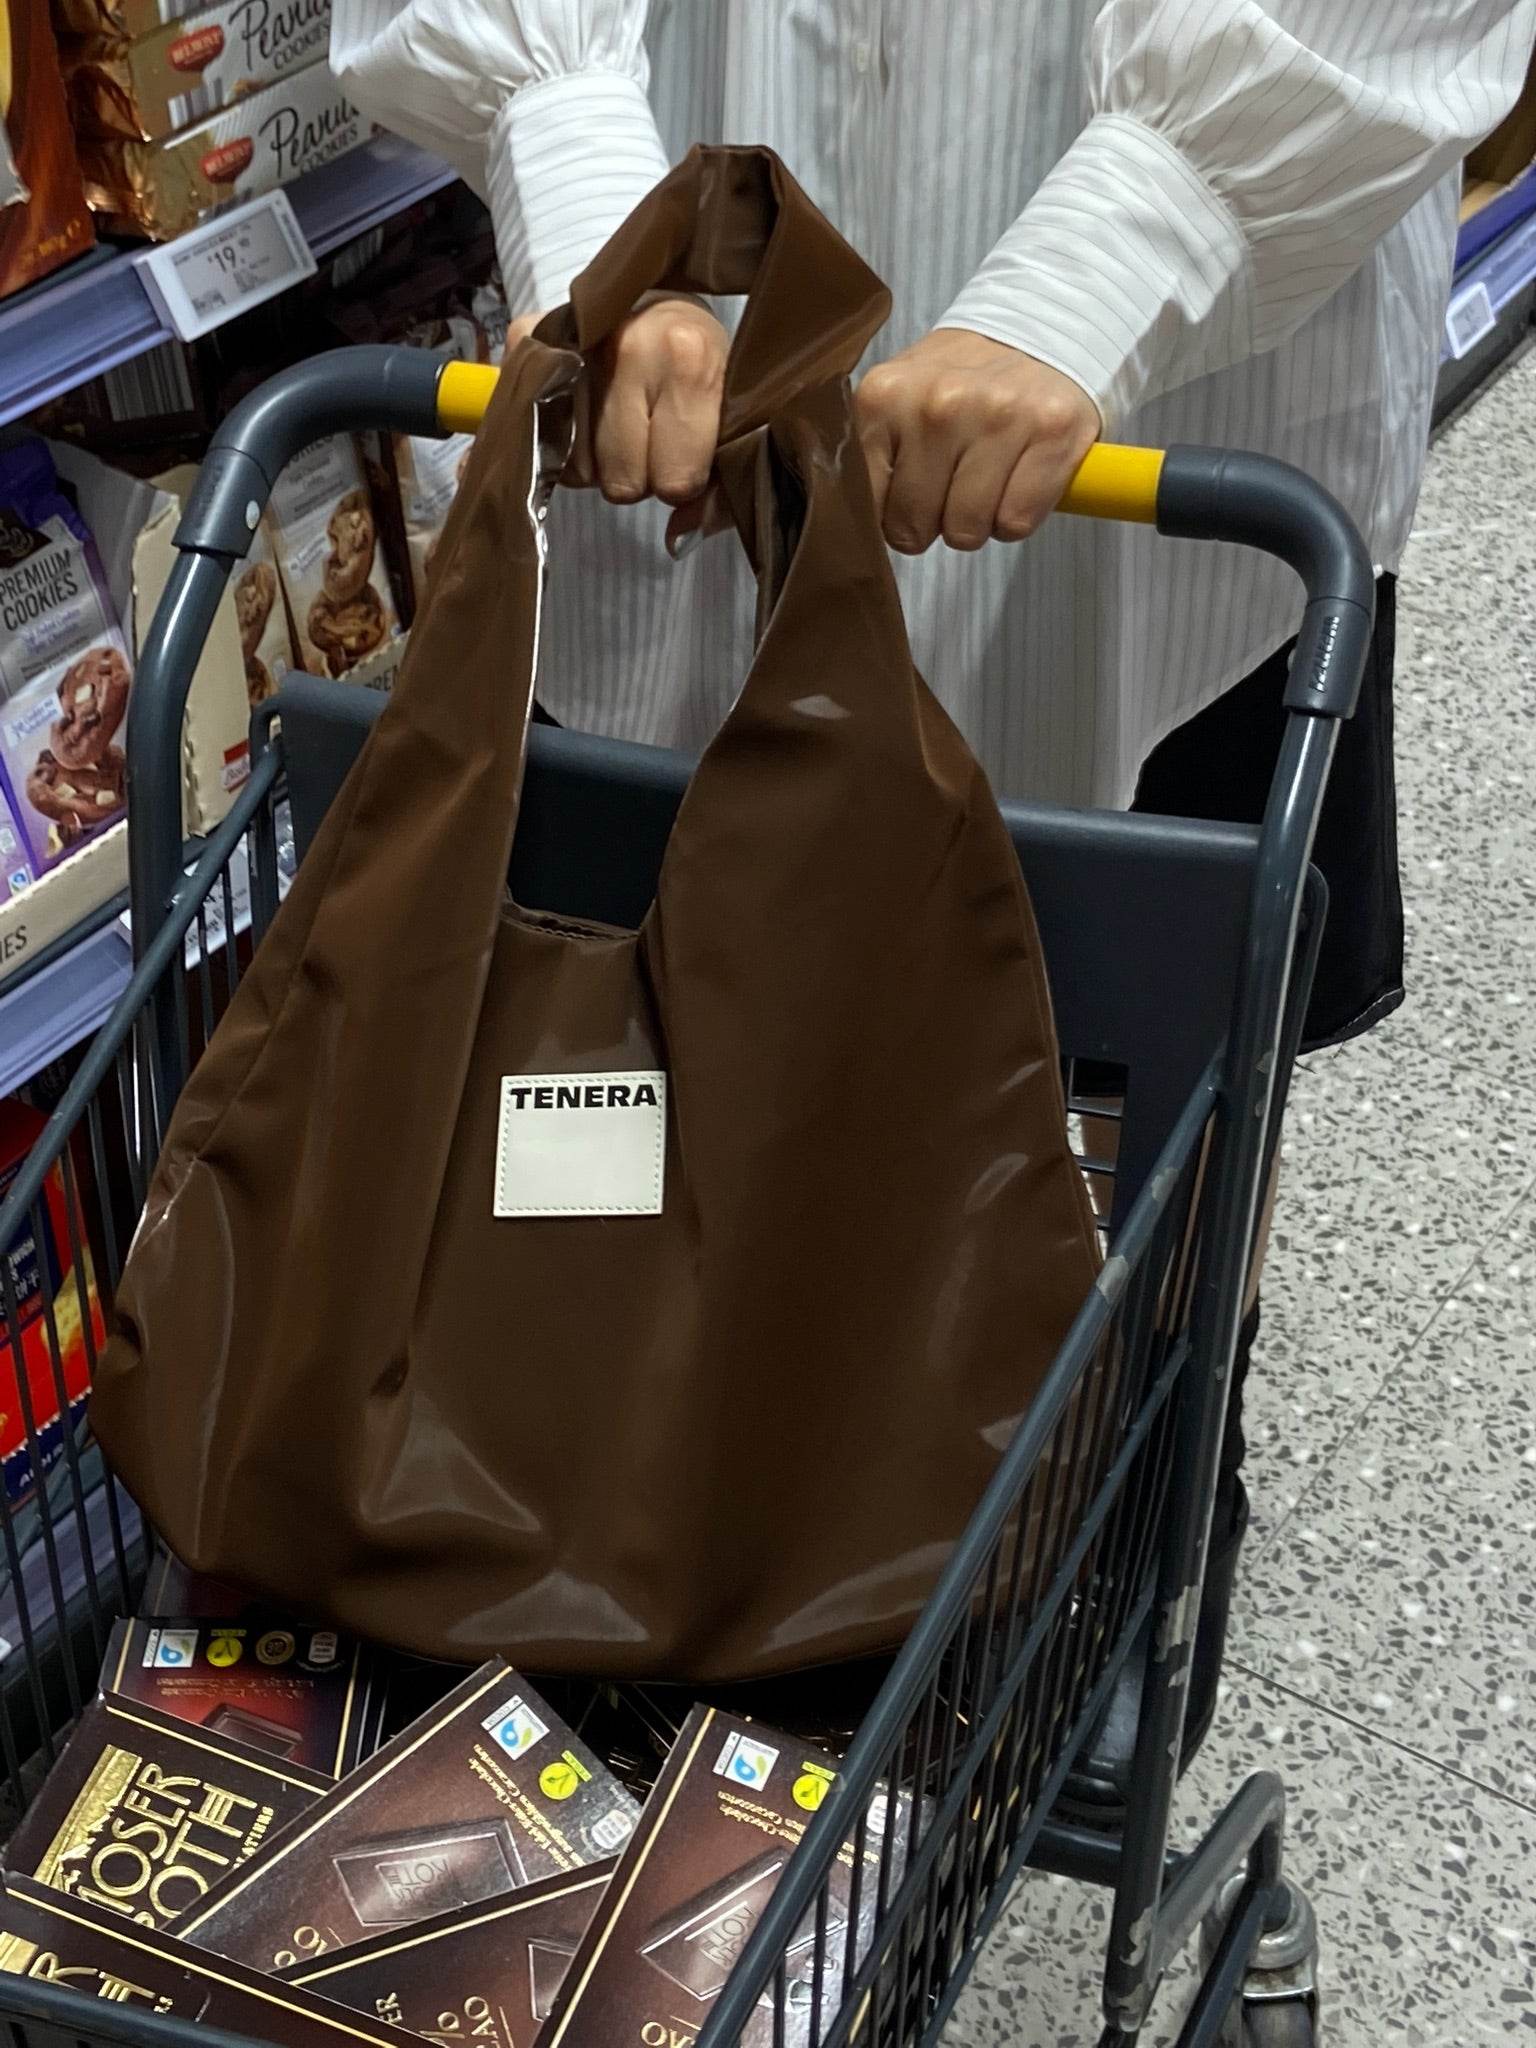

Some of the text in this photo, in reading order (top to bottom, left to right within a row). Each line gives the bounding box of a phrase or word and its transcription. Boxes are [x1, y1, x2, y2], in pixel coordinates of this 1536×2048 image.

[0, 549, 71, 606] PREMIUM
[4, 572, 78, 632] COOKIES
[510, 1084, 657, 1109] TENERA
[134, 1783, 258, 1928] OTH
